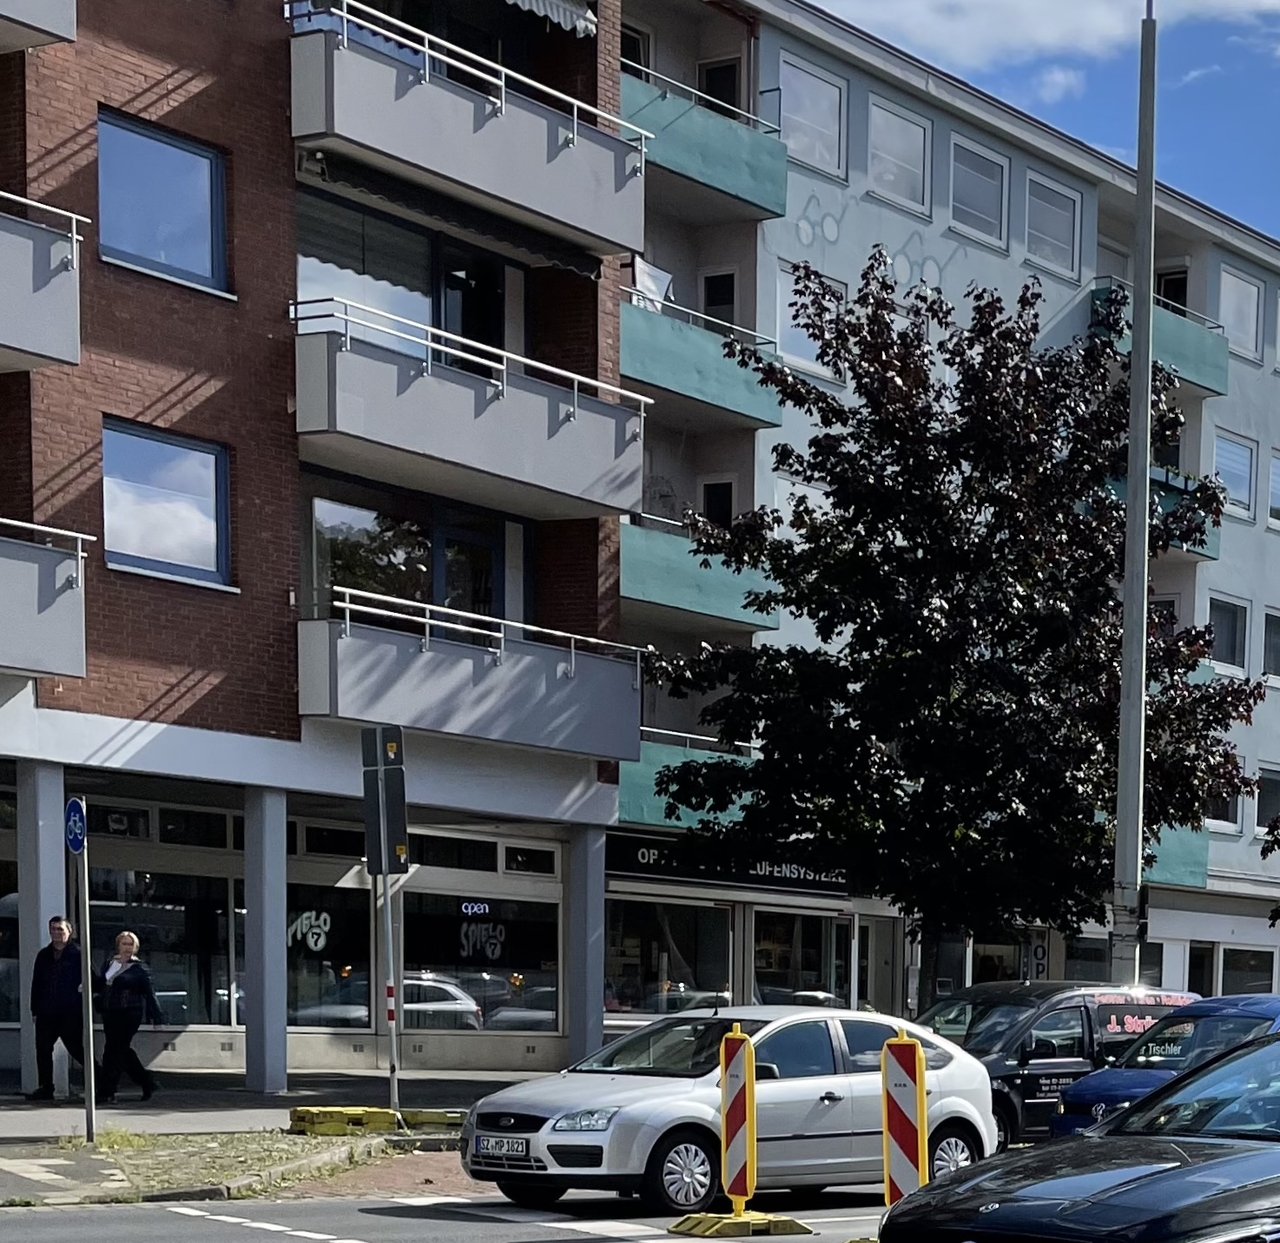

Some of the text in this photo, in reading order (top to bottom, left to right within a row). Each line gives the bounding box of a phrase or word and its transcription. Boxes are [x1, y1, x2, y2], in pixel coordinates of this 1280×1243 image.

[461, 902, 489, 914] open
[460, 921, 505, 958] SPIELO
[1147, 1042, 1183, 1056] Tischler
